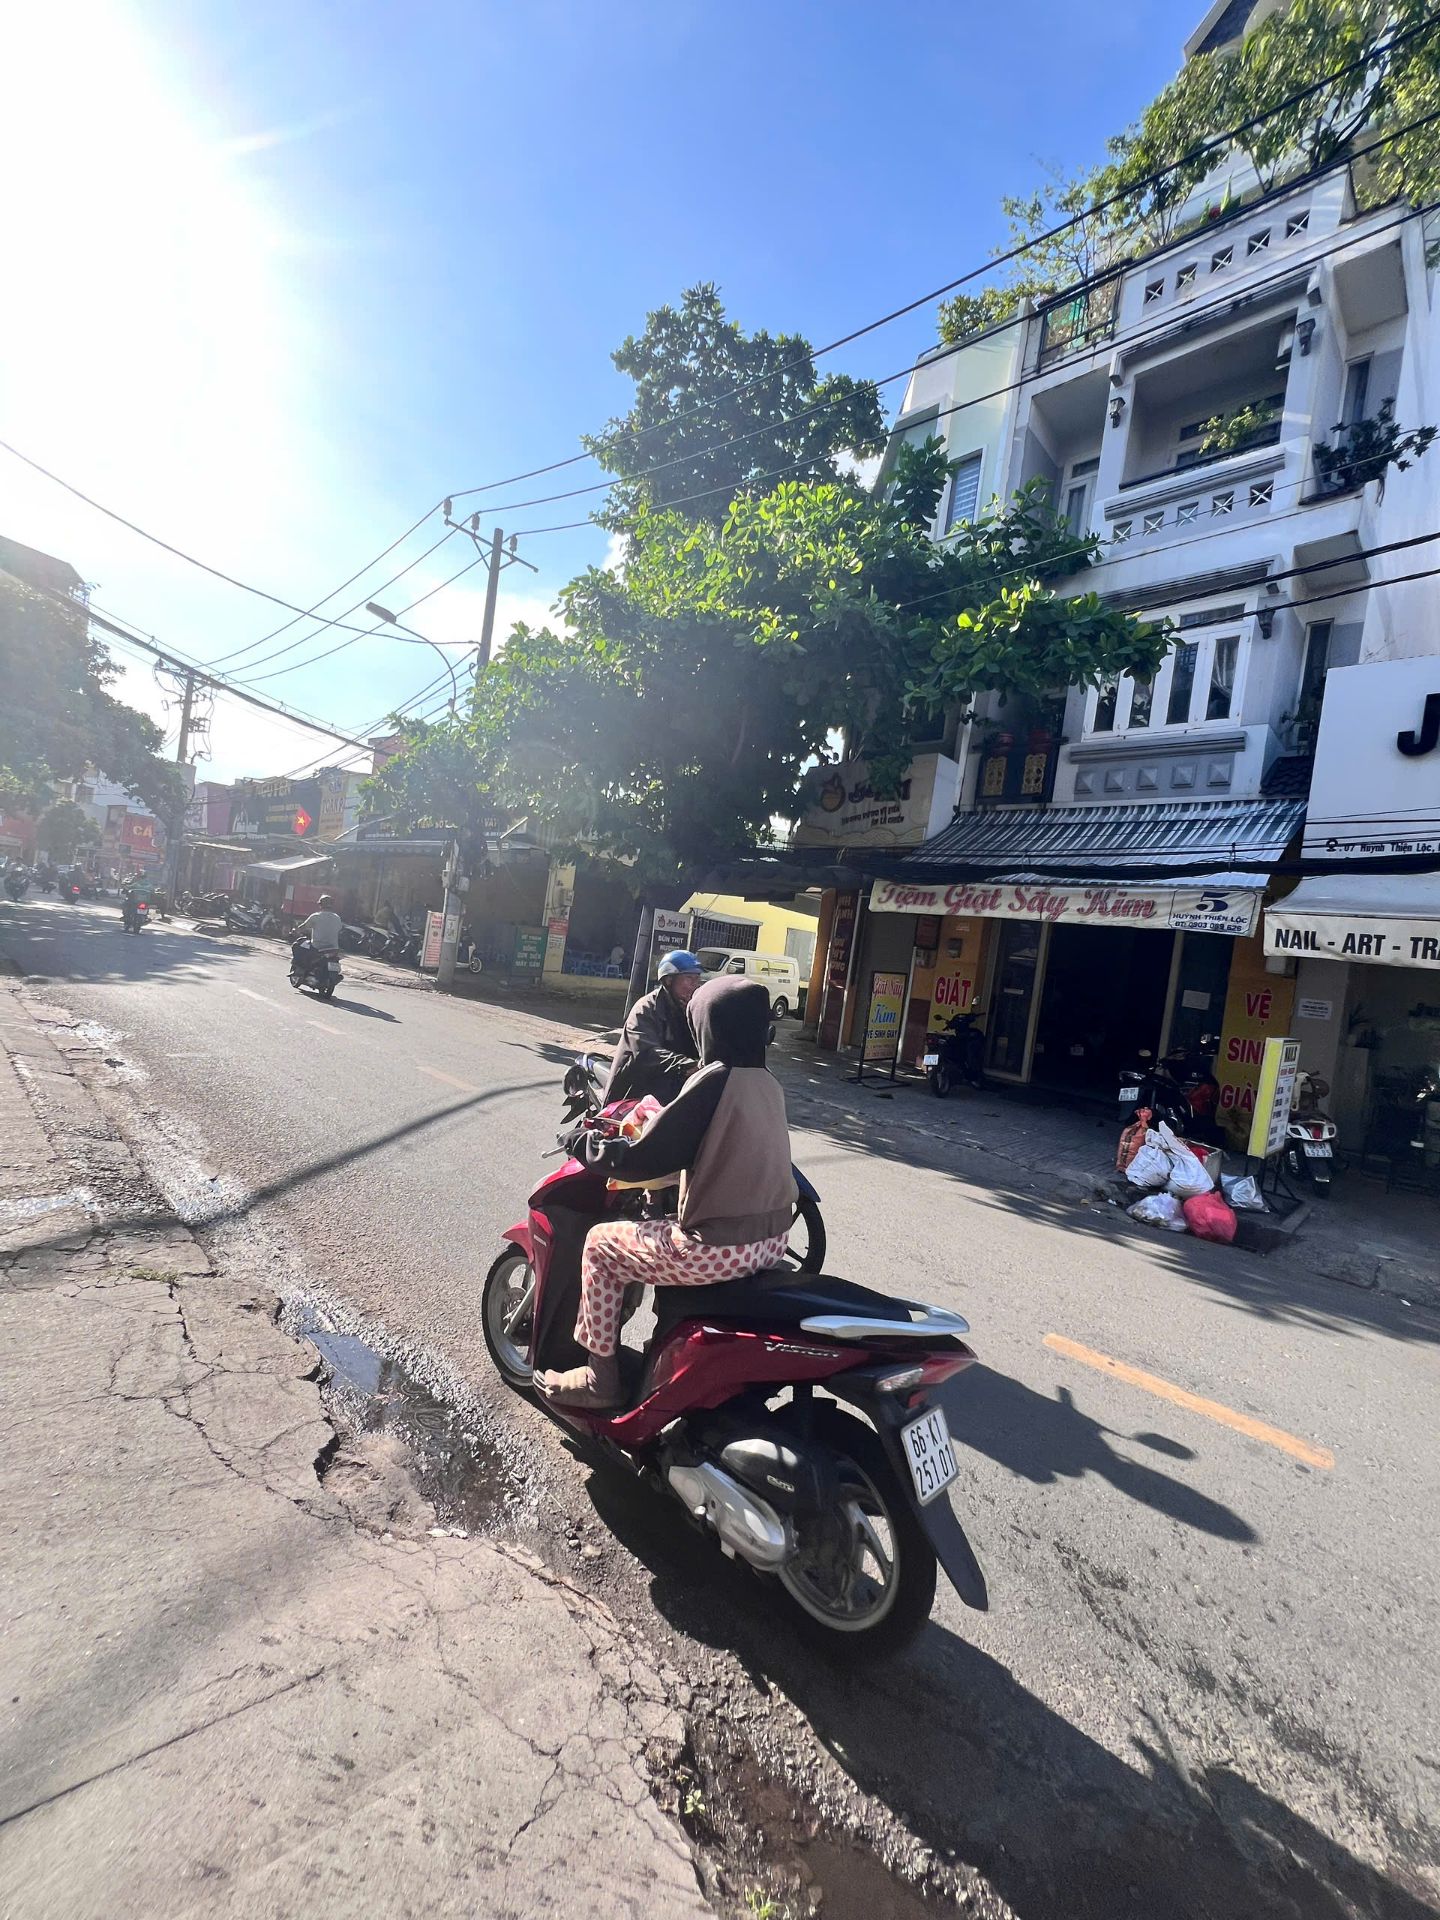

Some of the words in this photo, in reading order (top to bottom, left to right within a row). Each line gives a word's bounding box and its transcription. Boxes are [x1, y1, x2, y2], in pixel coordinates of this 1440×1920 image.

[1397, 693, 1440, 756] J
[878, 883, 937, 909] Tiệm
[943, 884, 1002, 914] Giặt
[1007, 885, 1069, 921] Sấy
[1077, 887, 1157, 919] Kim
[1196, 891, 1229, 912] 5
[1204, 914, 1229, 923] THIỆN
[1231, 916, 1248, 925] LỘC
[1275, 928, 1321, 951] NAIL
[1341, 932, 1386, 956] ART
[935, 972, 971, 1014] GIẶT
[1246, 988, 1273, 1026] VỆ
[1220, 1082, 1258, 1113] GIÀ
[910, 1414, 944, 1459] 66-K1
[915, 1443, 956, 1498] 251.01
